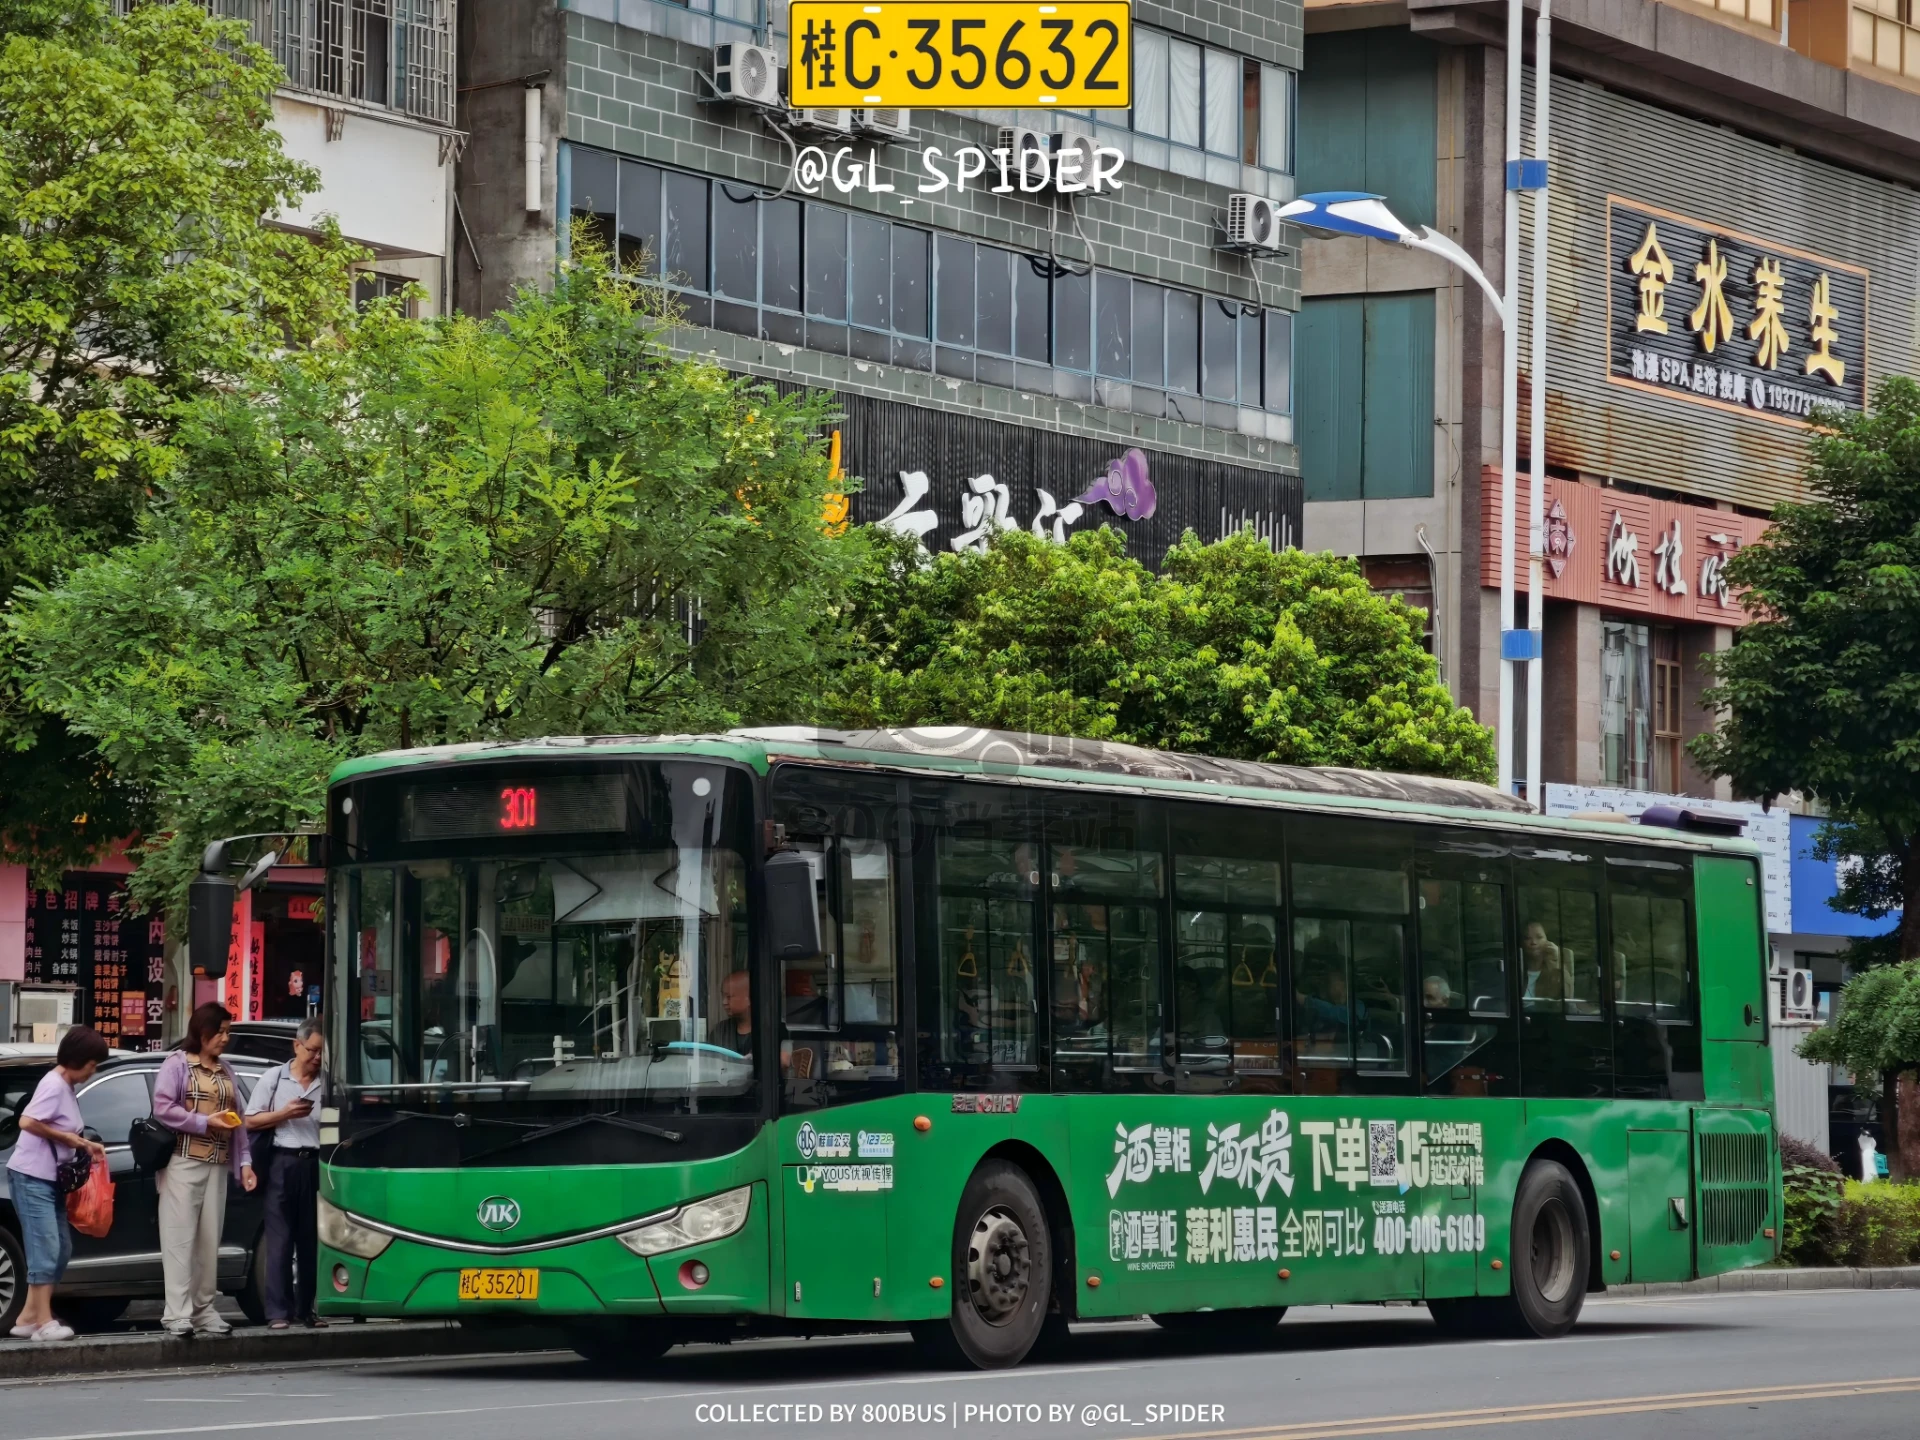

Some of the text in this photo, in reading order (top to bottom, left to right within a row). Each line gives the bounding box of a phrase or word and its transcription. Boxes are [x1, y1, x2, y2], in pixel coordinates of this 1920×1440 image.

[1629, 221, 1845, 387] 金水养生
[1661, 357, 1691, 387] SPA
[1691, 365, 1717, 396] 足浴
[500, 787, 536, 829] 301
[1105, 1121, 1192, 1200] 酒掌柜
[1300, 1118, 1369, 1192] 下单
[1123, 1209, 1178, 1259] 酒掌柜
[1373, 1214, 1485, 1255] 400-006-6199
